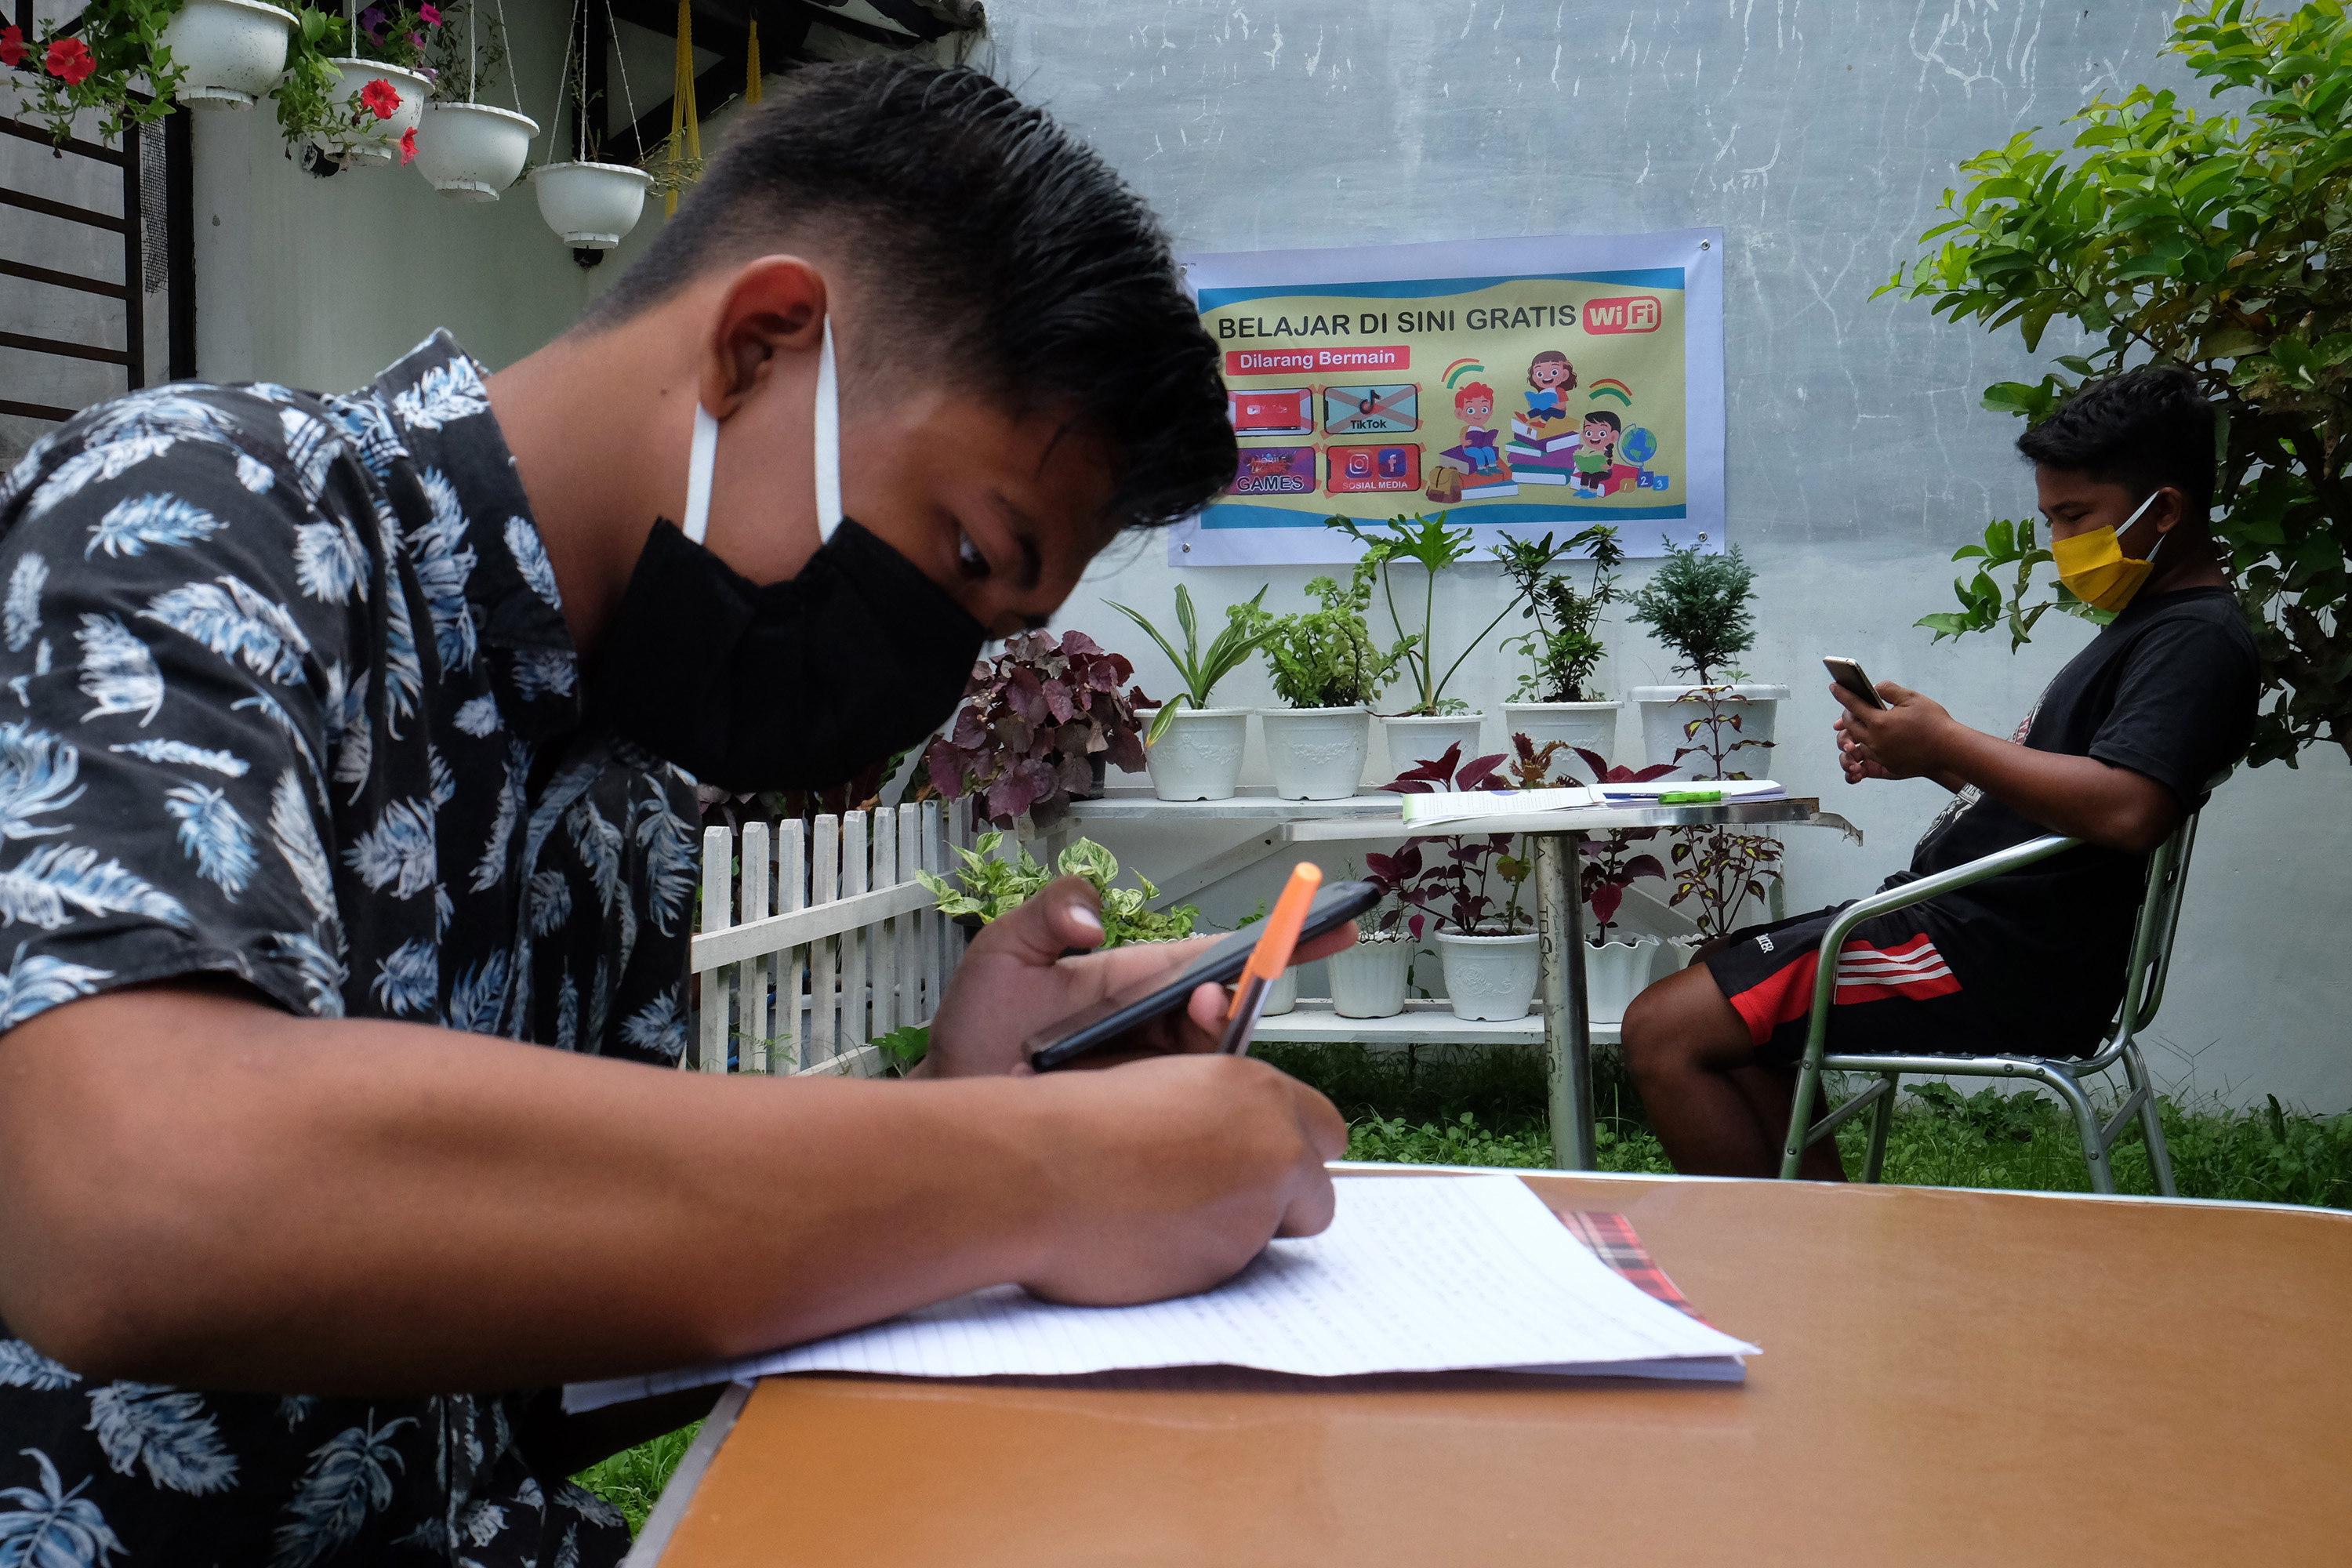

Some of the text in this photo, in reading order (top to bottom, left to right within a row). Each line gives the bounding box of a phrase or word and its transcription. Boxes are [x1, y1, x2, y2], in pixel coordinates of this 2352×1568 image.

[1218, 314, 1351, 339] BELAJAR
[1359, 312, 1387, 335] DI
[1397, 310, 1455, 332] SINI
[1466, 304, 1577, 330] GRATIS
[1240, 350, 1396, 370] Dilarang Bermain
[1261, 404, 1287, 414] YTbe
[1350, 419, 1387, 430] TikTok
[1236, 475, 1304, 492] GAMES
[1342, 481, 1408, 490] SOSIAL MEDIA
[1640, 476, 1649, 486] 2
[1656, 480, 1663, 489] 3
[1538, 906, 1552, 980] TOSKA
